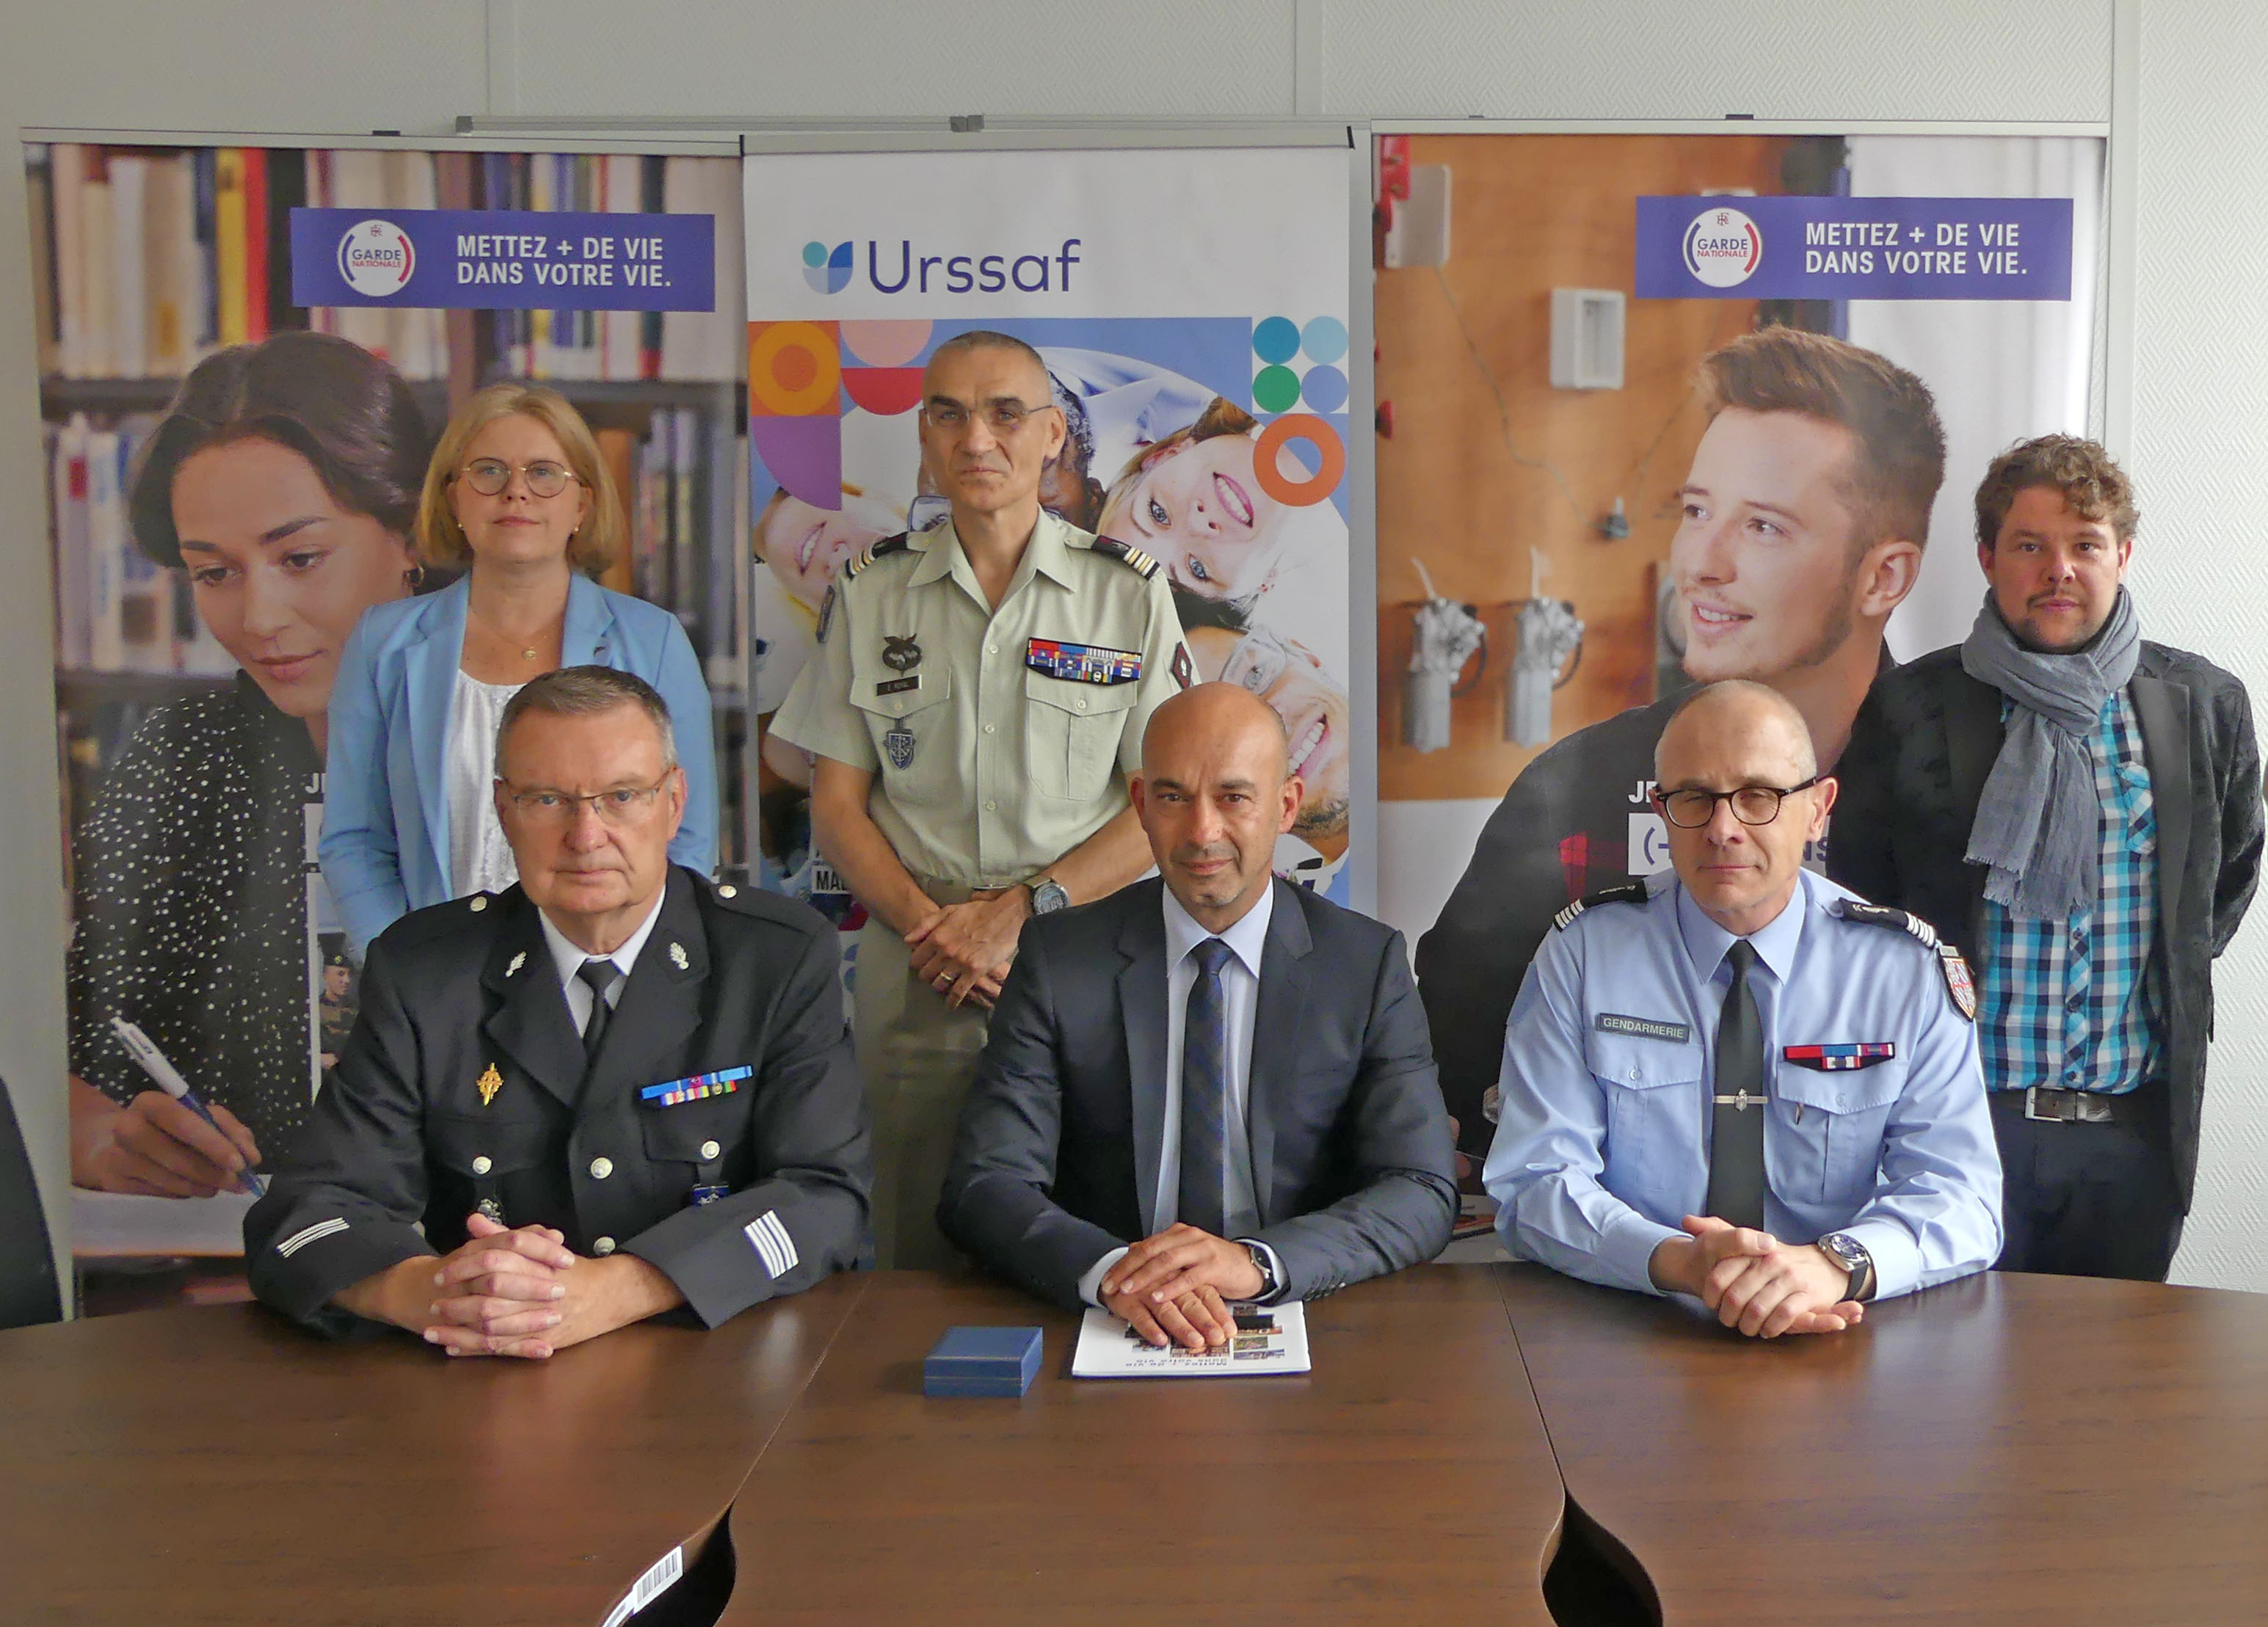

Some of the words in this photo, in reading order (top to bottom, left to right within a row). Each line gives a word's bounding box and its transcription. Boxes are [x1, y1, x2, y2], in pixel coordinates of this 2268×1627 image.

[1698, 239, 1748, 250] GARDE
[1806, 222, 1899, 246] METTEZ
[1908, 226, 1925, 244] +
[1936, 223, 1969, 247] DE
[1979, 223, 2020, 247] VIE
[352, 249, 401, 261] GARDE
[457, 235, 548, 258] METTEZ
[556, 239, 573, 256] +
[583, 237, 614, 259] DE
[623, 238, 663, 260] VIE
[457, 261, 523, 285] DANS
[534, 263, 614, 285] VOTRE
[623, 264, 672, 287] VIE.
[868, 239, 1081, 294] Urssaf
[1806, 251, 1874, 274] DANS
[1884, 251, 1966, 274] VOTRE
[1978, 252, 2028, 274] VIE.
[305, 772, 327, 794] J
[1603, 1017, 1684, 1038] GENDARMERIE
